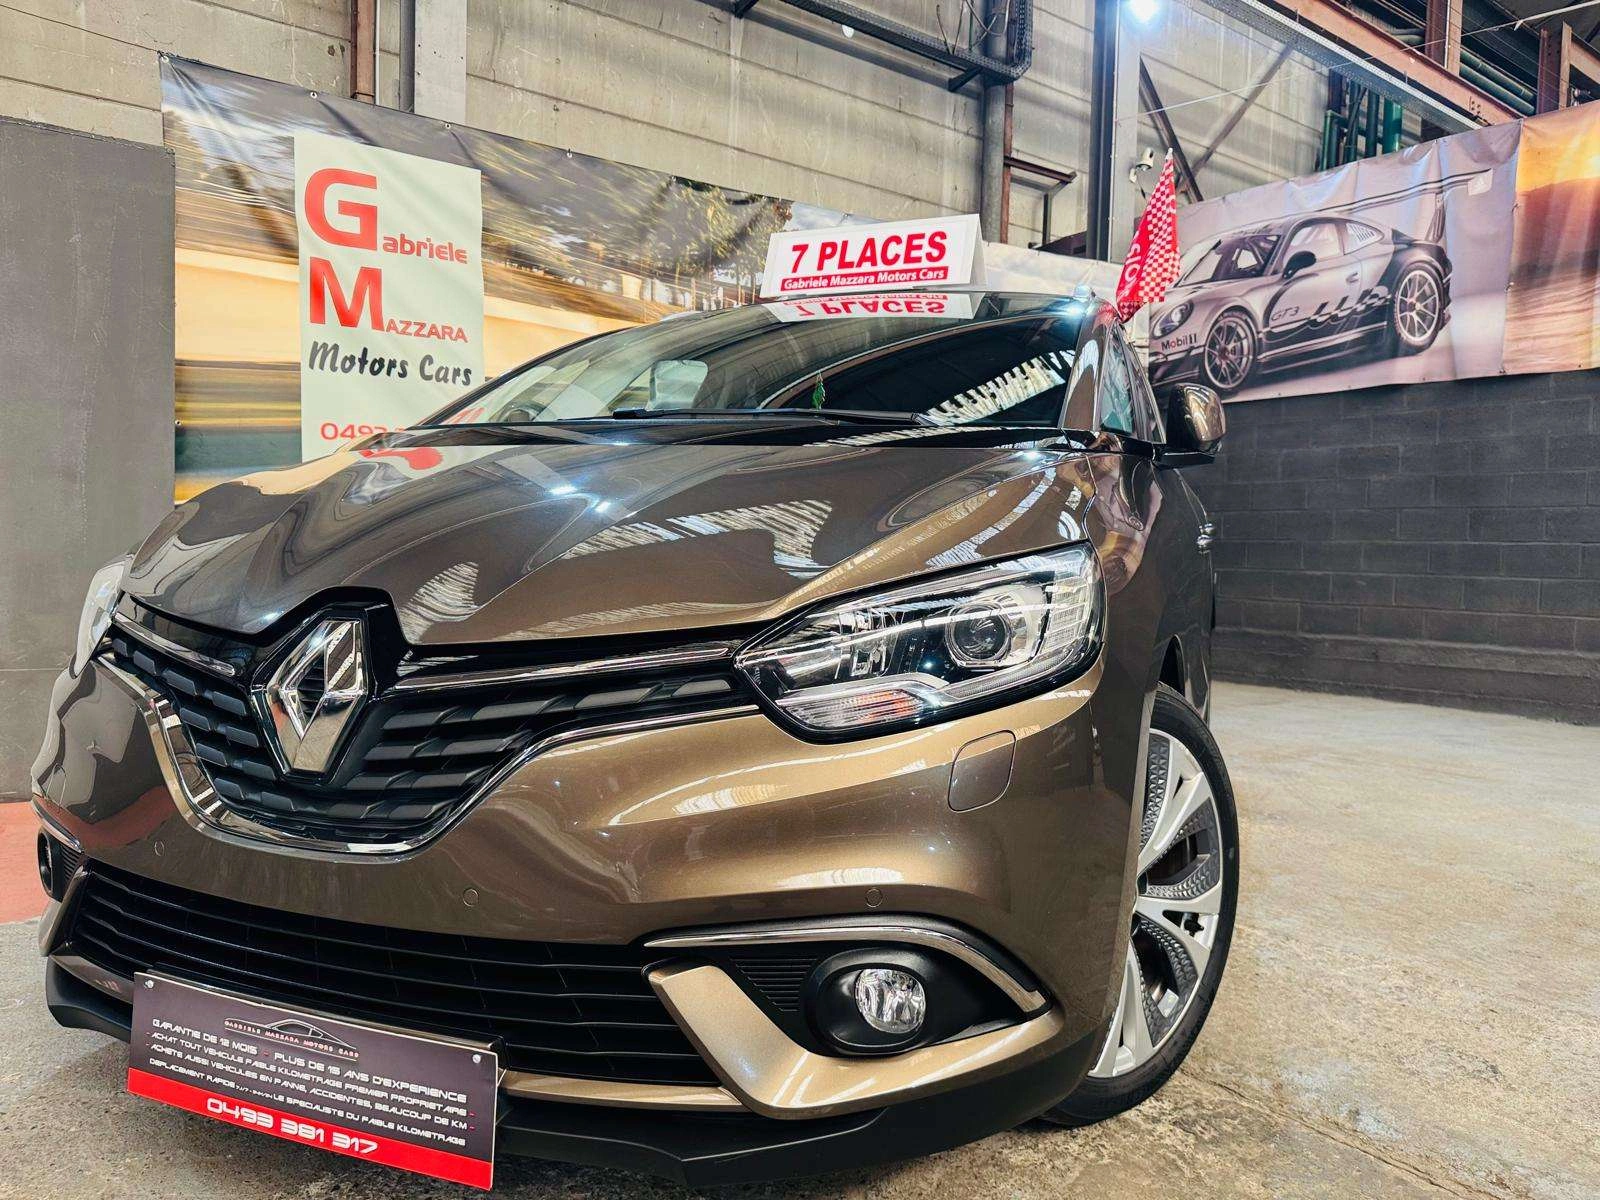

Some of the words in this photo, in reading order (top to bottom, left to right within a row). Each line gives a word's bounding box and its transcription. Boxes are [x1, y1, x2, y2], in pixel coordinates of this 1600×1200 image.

[784, 275, 828, 289] Gabriele
[830, 273, 875, 286] Mazzara
[878, 269, 917, 283] Motors
[920, 267, 944, 281] Cars
[791, 244, 809, 274] 7
[816, 230, 947, 272] PLACES
[309, 256, 468, 343] MAZZARA
[308, 340, 408, 379] Motors
[419, 354, 472, 386] Cars
[149, 1057, 205, 1080] DEPLACEMENT
[206, 1074, 236, 1089] RAPIDE
[273, 1093, 285, 1102] LE
[286, 1096, 344, 1118] SPECIALISTE
[345, 1112, 360, 1121] DU
[362, 1115, 395, 1130] FAIBLE
[396, 1124, 466, 1146] KILOMETRAGE
[150, 1043, 183, 1058] ACHETE
[184, 1054, 209, 1066] AUSSI
[210, 1060, 258, 1080] VEHICULES
[259, 1074, 273, 1084] EN
[274, 1078, 308, 1094] PANNE,
[374, 1102, 432, 1122] BEAUCOUP
[434, 1116, 450, 1126] DE
[451, 1119, 468, 1130] KM
[151, 1032, 178, 1044] ACHAT
[180, 1039, 202, 1051] TOUT
[204, 1046, 244, 1064] VEHICULE
[245, 1056, 276, 1072] FAIBLE
[278, 1066, 343, 1088] KILOMETRAGE
[344, 1082, 389, 1100] PREMIER
[390, 1094, 467, 1117] PROPRIETAIRE
[152, 1018, 200, 1039] GARANTIE
[203, 1033, 218, 1044] DE
[232, 1040, 259, 1056] MOIS
[274, 1052, 306, 1067] PLUS
[308, 1060, 325, 1072] DE
[344, 1070, 370, 1083] ANS
[372, 1076, 468, 1104] D'EXPERIENCE
[206, 1098, 274, 1129] 0493
[280, 1118, 325, 1143] 381
[332, 1132, 378, 1154] 317
